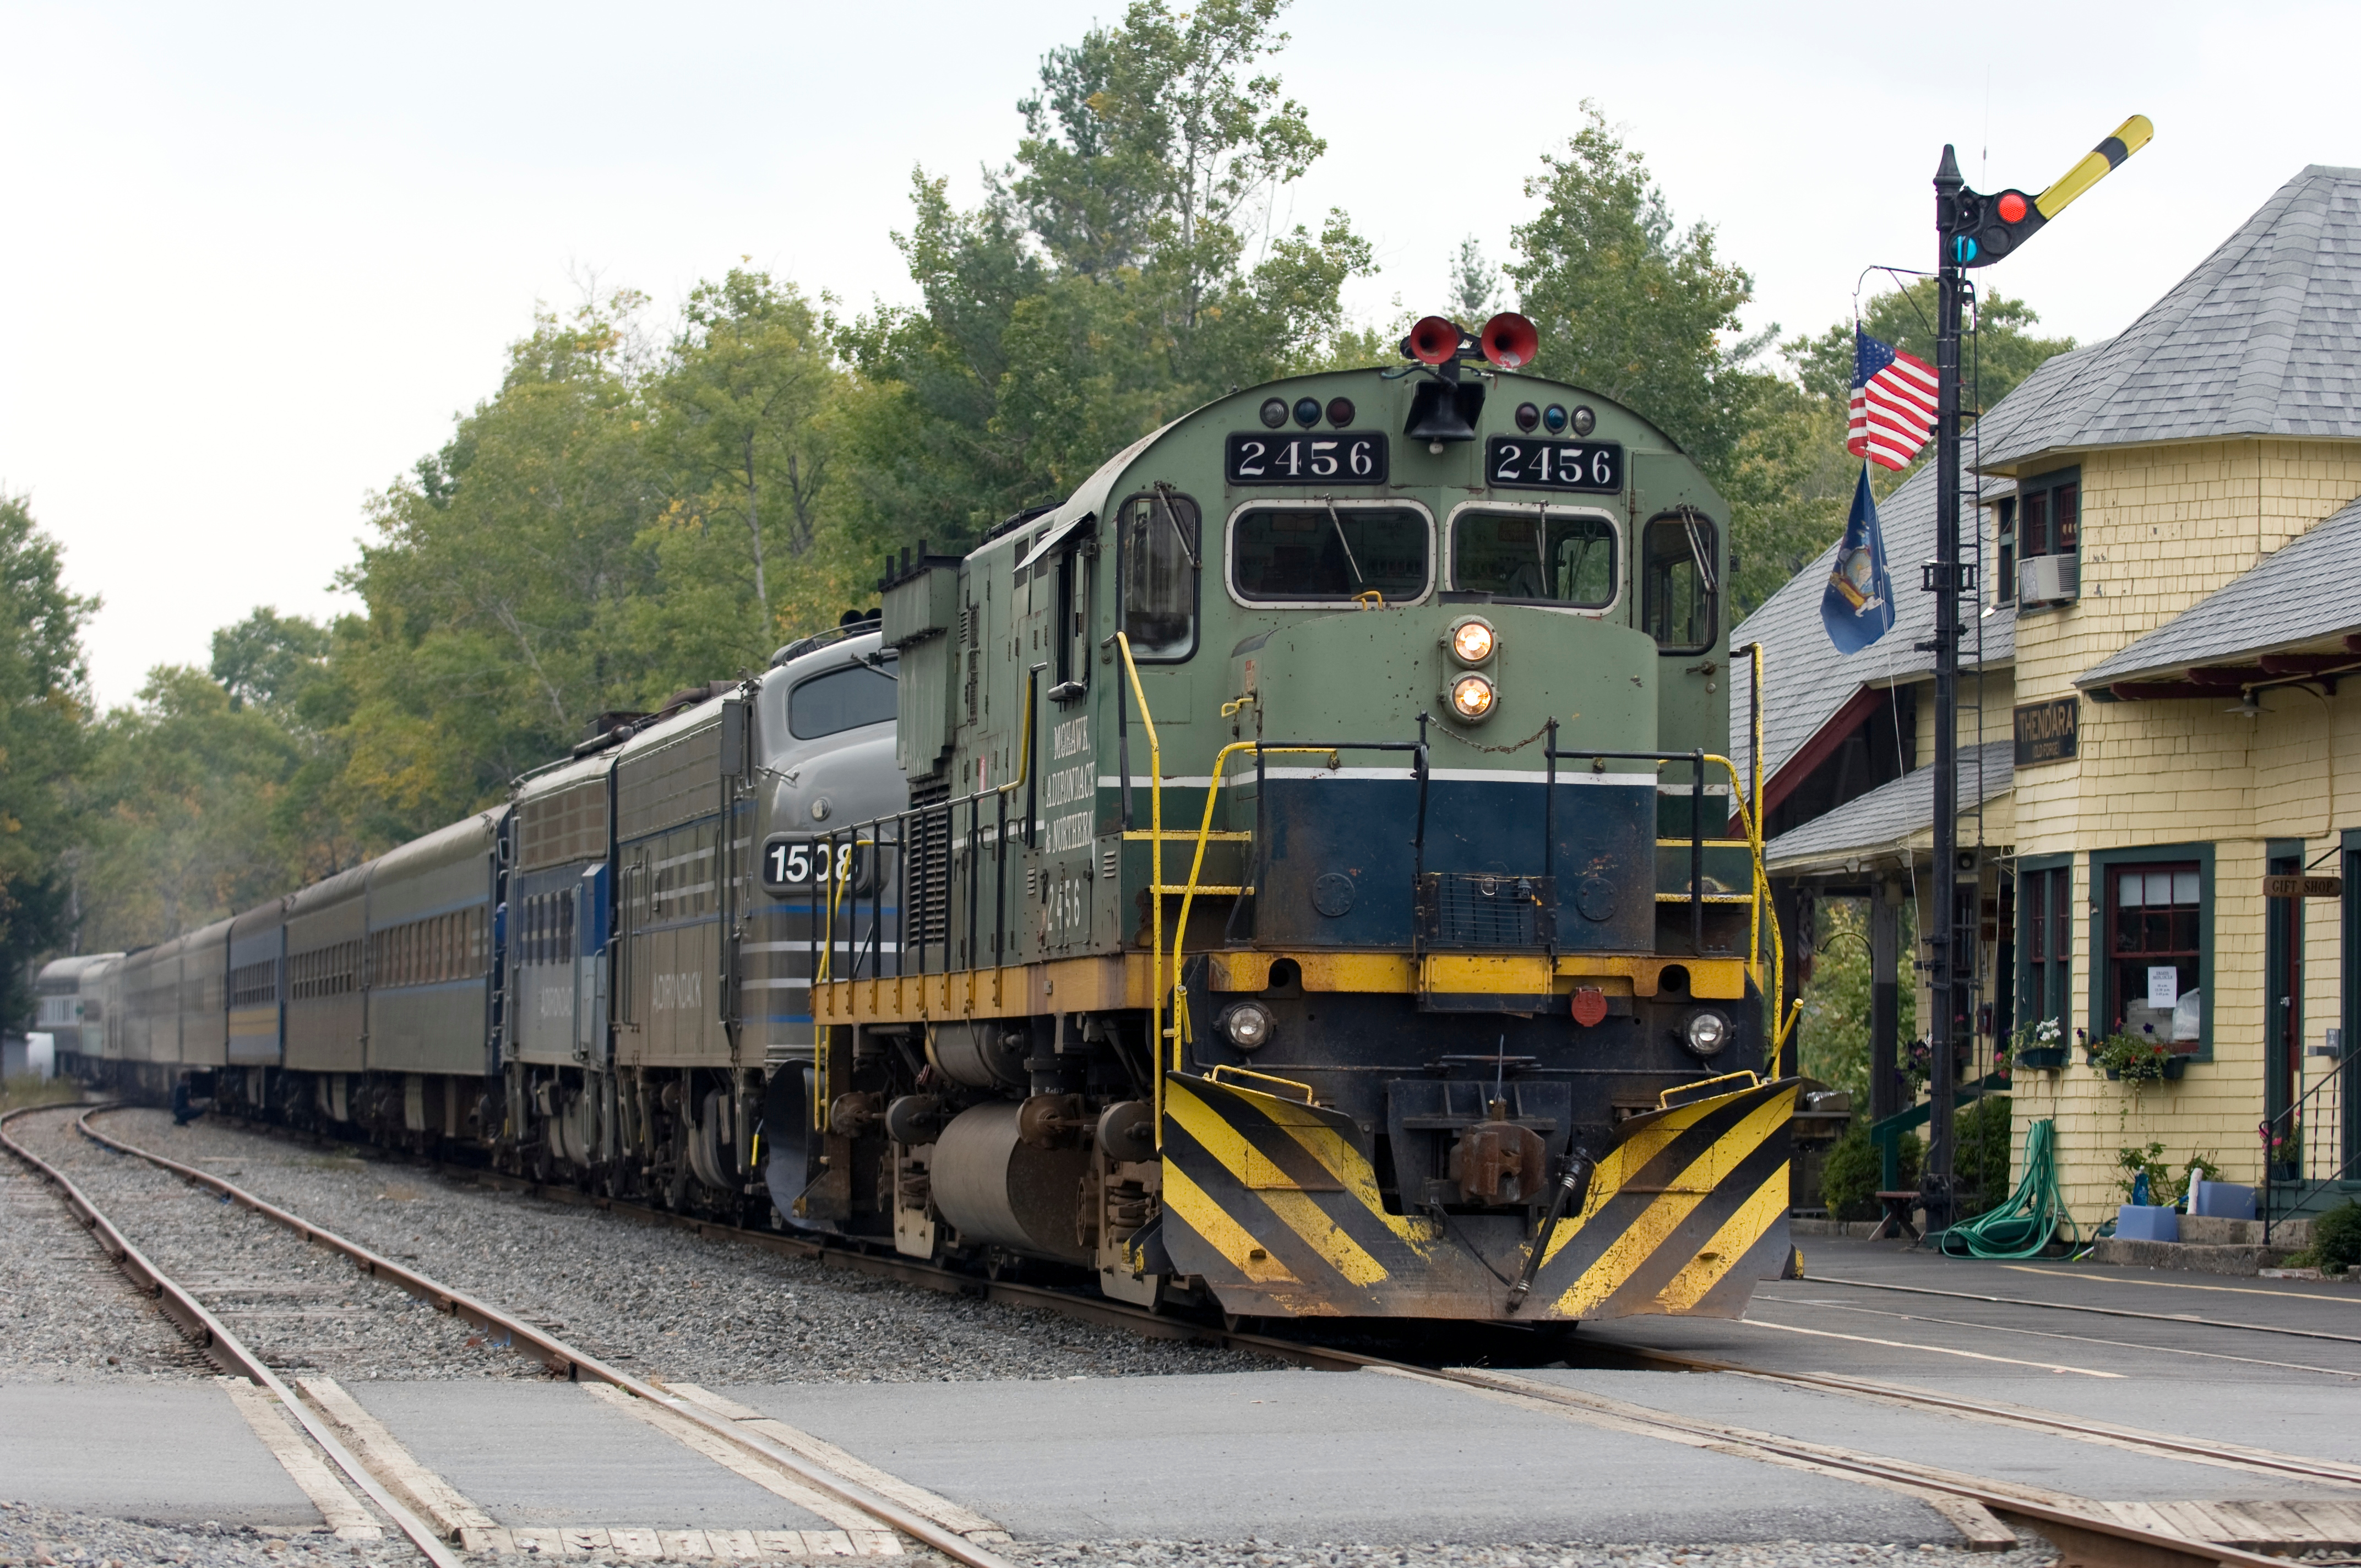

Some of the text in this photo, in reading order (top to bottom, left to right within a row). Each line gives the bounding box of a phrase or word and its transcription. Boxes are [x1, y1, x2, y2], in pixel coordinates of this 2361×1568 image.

[1239, 440, 1373, 476] 2456
[1497, 445, 1611, 484] 2456
[1054, 715, 1090, 760] MOHAWK,
[2018, 704, 2074, 742] THENDARA
[1046, 761, 1095, 808] ADIRONDACK
[1046, 810, 1094, 854] & NORTHERN
[771, 843, 858, 882] 1508
[1048, 878, 1080, 931] 2456
[2272, 880, 2333, 893] GIFT SHOP
[541, 986, 574, 1020] ADIRONDAC
[652, 971, 702, 1012] ADIRONDACK
